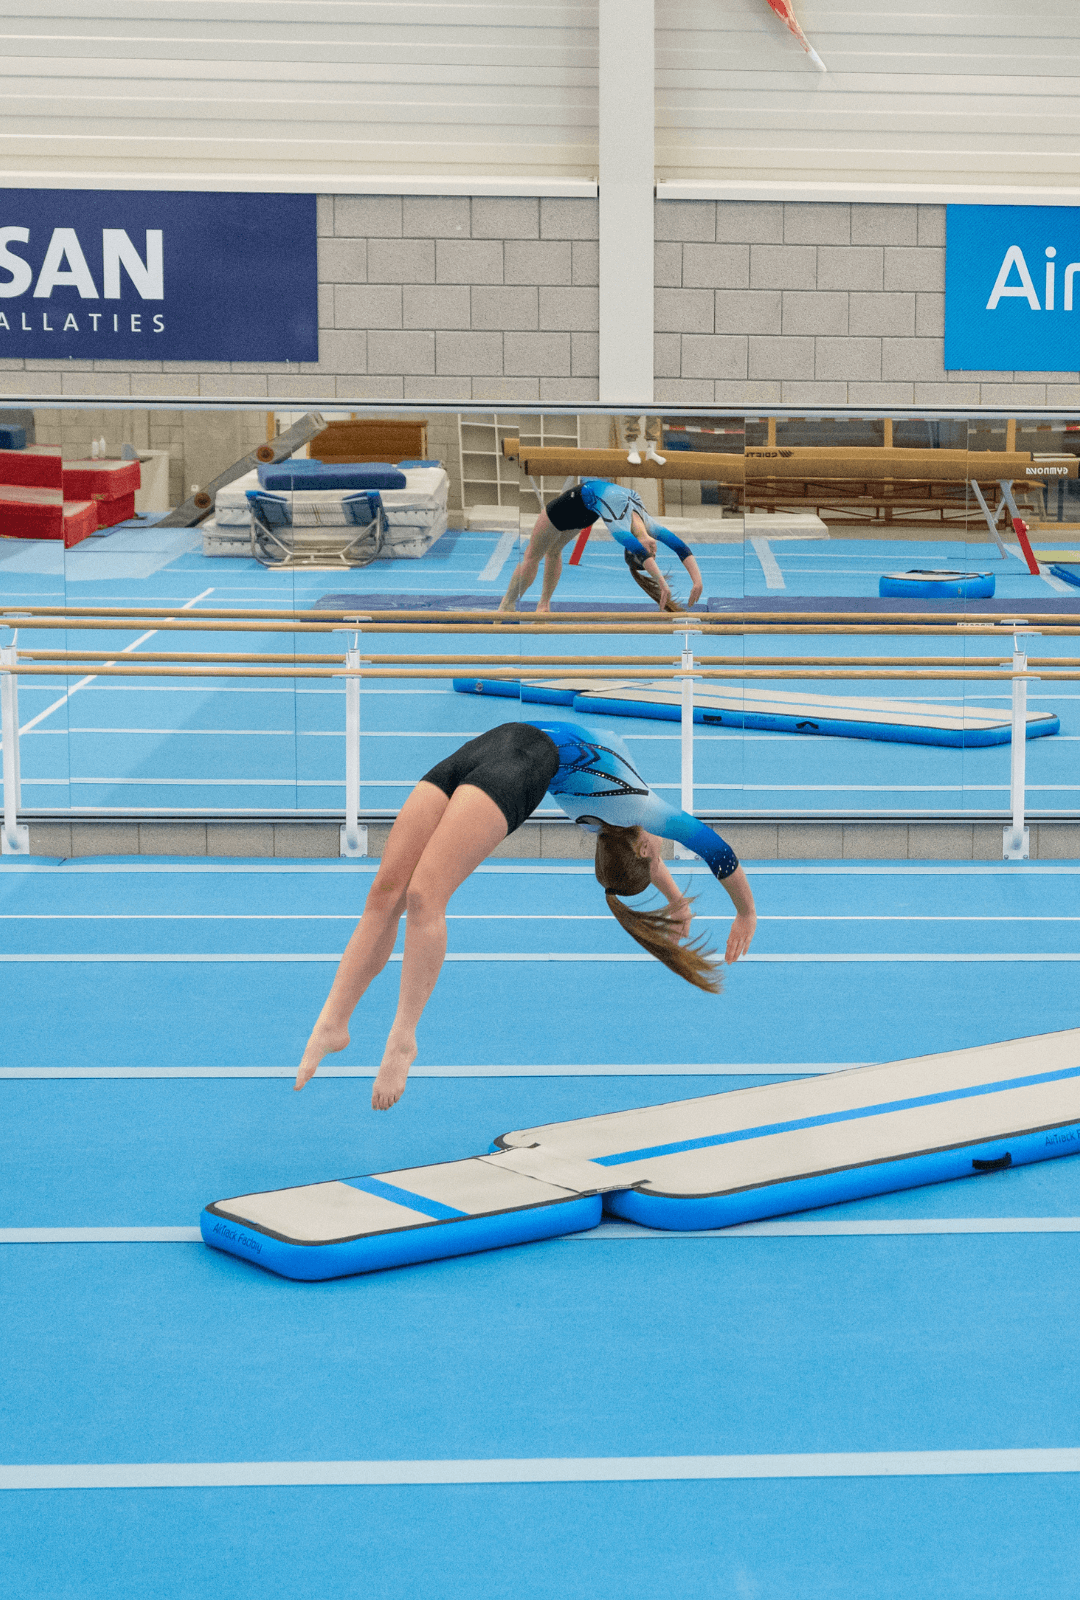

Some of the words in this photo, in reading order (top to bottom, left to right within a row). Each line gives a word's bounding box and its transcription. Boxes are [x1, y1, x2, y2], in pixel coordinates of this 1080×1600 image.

[0, 226, 164, 300] SAN
[986, 245, 1080, 311] Air
[0, 312, 165, 333] ALLATIES
[237, 1233, 263, 1254] Factory
